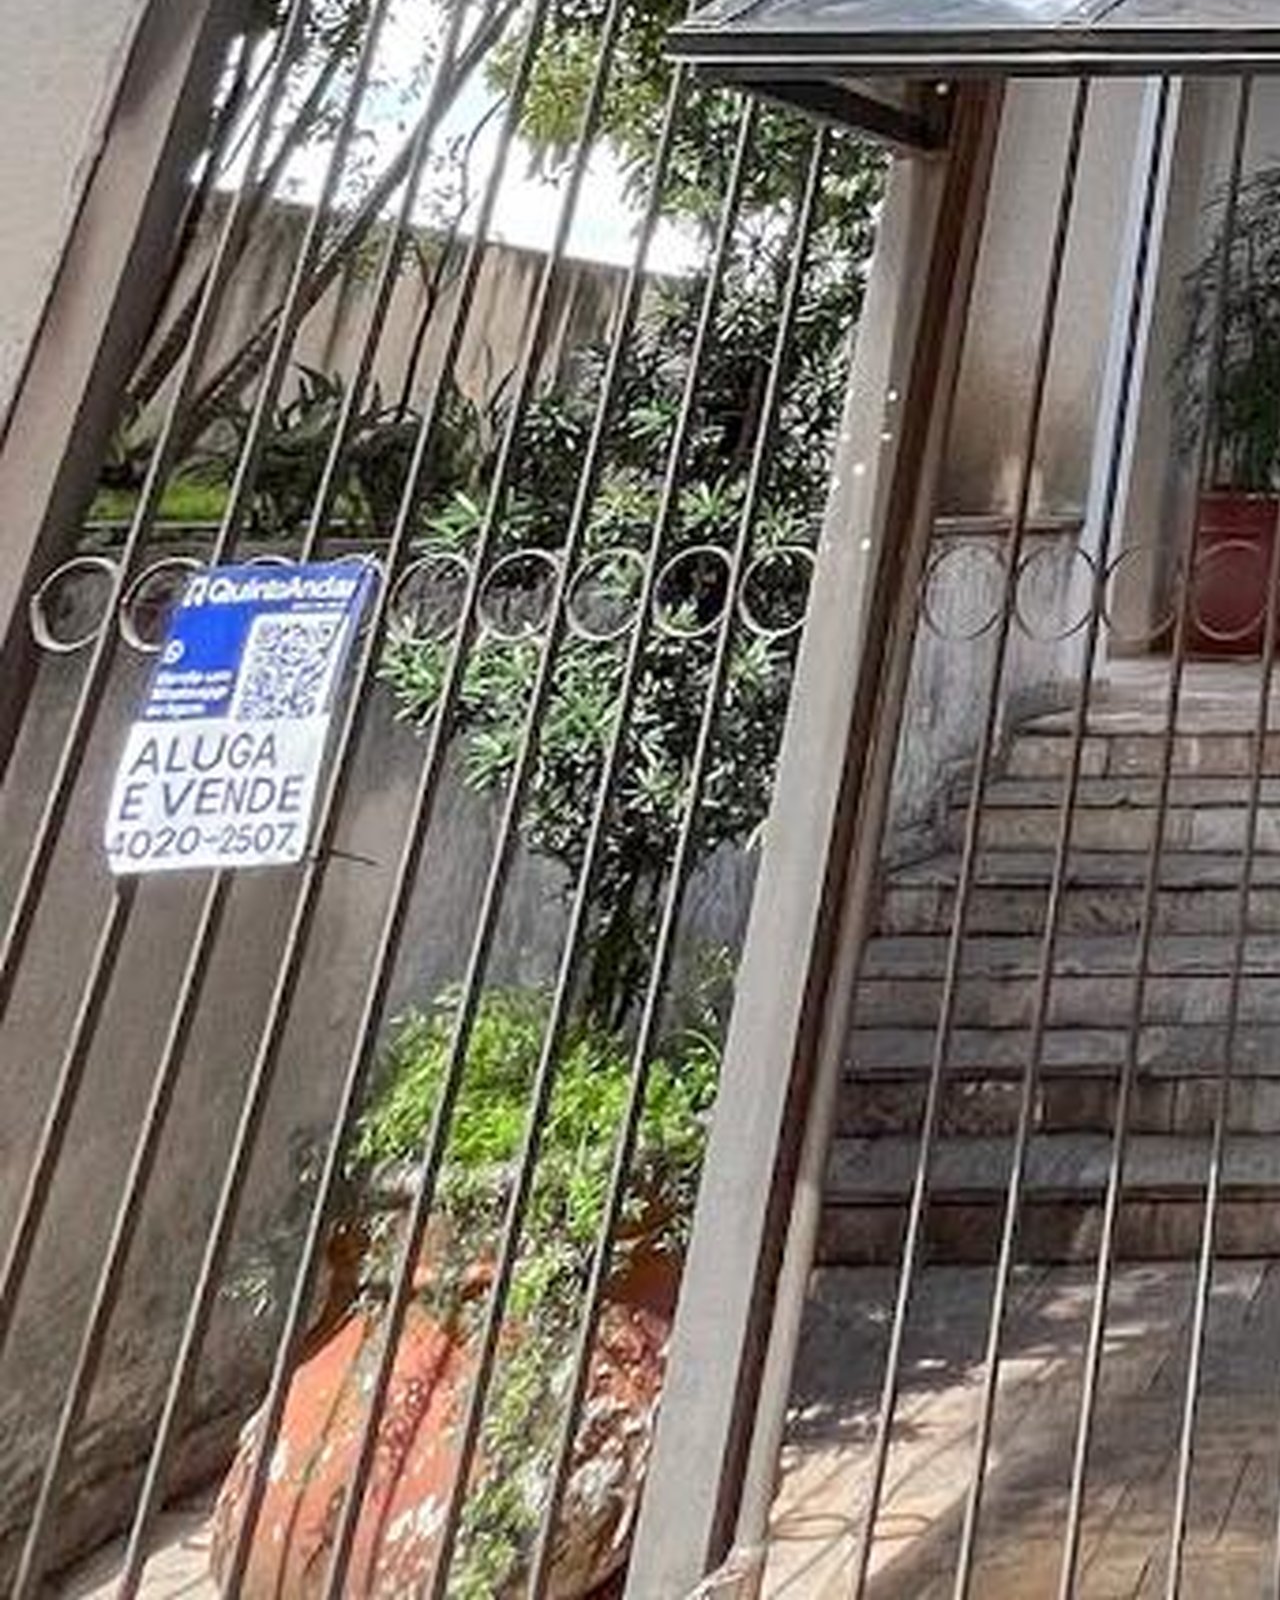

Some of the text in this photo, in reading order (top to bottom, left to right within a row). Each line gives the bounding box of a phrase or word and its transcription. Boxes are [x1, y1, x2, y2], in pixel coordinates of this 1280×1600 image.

[128, 732, 278, 776] ALUGA
[118, 774, 305, 822] E VENDE
